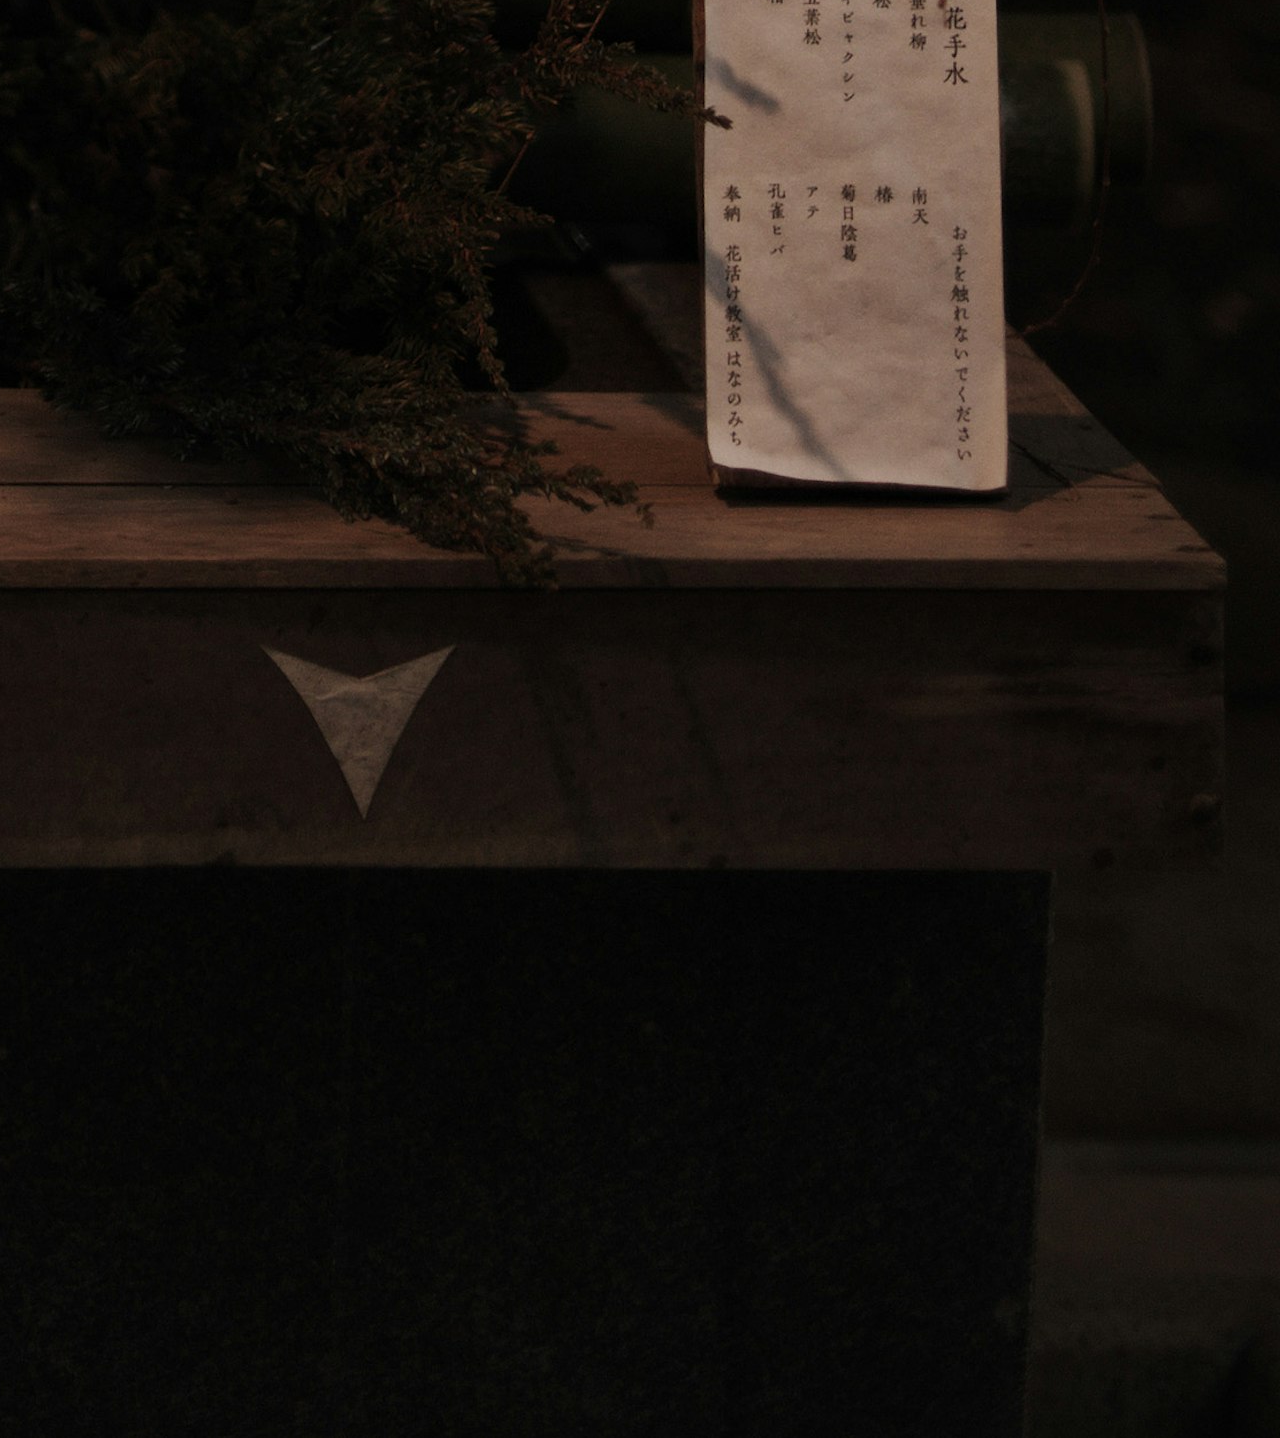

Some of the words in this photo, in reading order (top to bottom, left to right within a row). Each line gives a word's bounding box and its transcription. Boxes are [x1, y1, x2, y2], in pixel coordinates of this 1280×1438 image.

[723, 185, 741, 223] 奉納
[767, 184, 786, 256] 孔雀ヒバ
[806, 186, 820, 220] アテ
[874, 186, 894, 204] 椿
[911, 186, 929, 225] 南天
[725, 245, 742, 343] 花活け教室
[950, 226, 972, 462] お手を触れないでください
[726, 351, 744, 447] はなのみち
